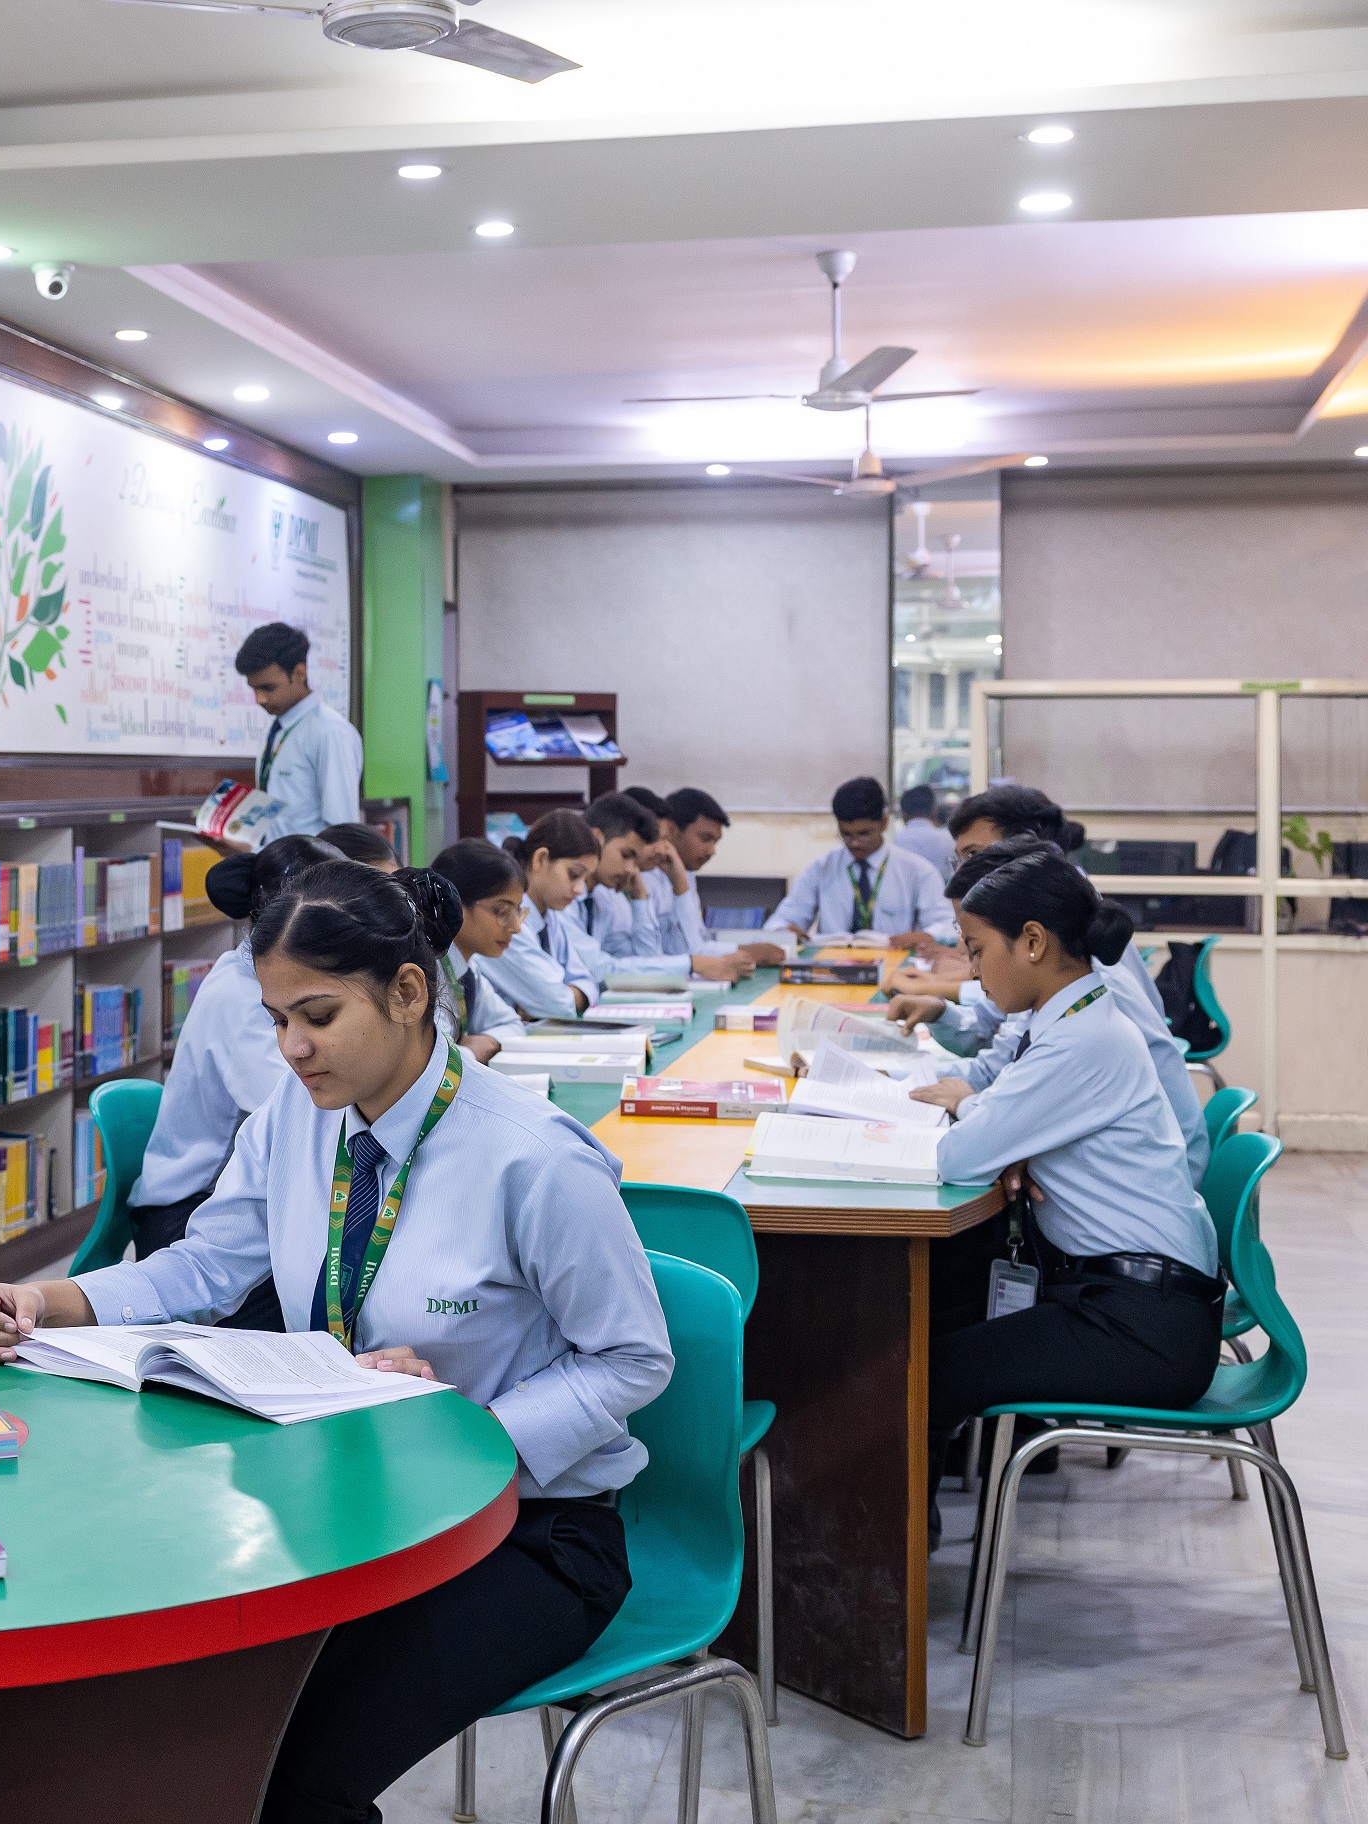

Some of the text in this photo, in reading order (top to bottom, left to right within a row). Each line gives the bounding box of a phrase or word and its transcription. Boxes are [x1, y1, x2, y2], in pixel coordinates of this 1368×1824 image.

[330, 1247, 340, 1286] DPMI
[358, 1260, 378, 1298] DPMI
[426, 1297, 479, 1315] DPMI
